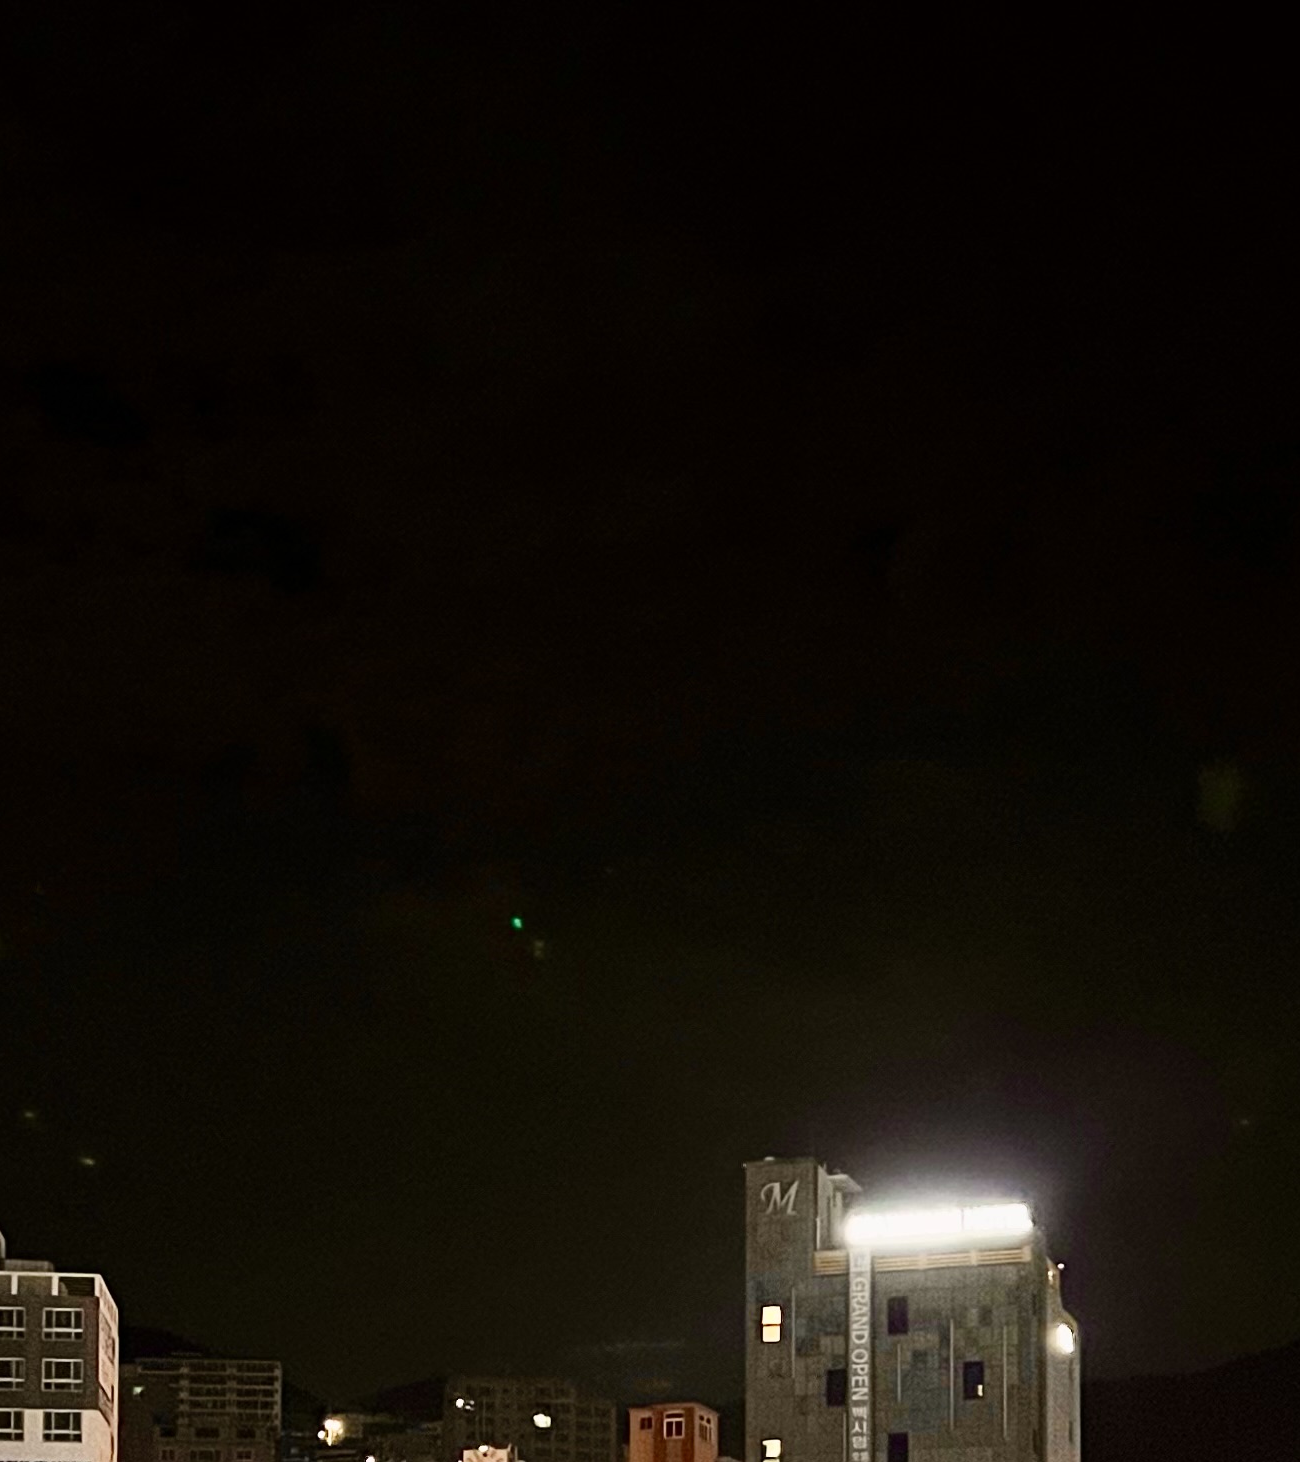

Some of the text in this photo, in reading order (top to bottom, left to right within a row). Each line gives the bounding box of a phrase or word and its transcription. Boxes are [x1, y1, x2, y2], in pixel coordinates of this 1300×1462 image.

[760, 1180, 800, 1216] M
[851, 1277, 870, 1344] GRAND
[851, 1349, 870, 1401] OPEN
